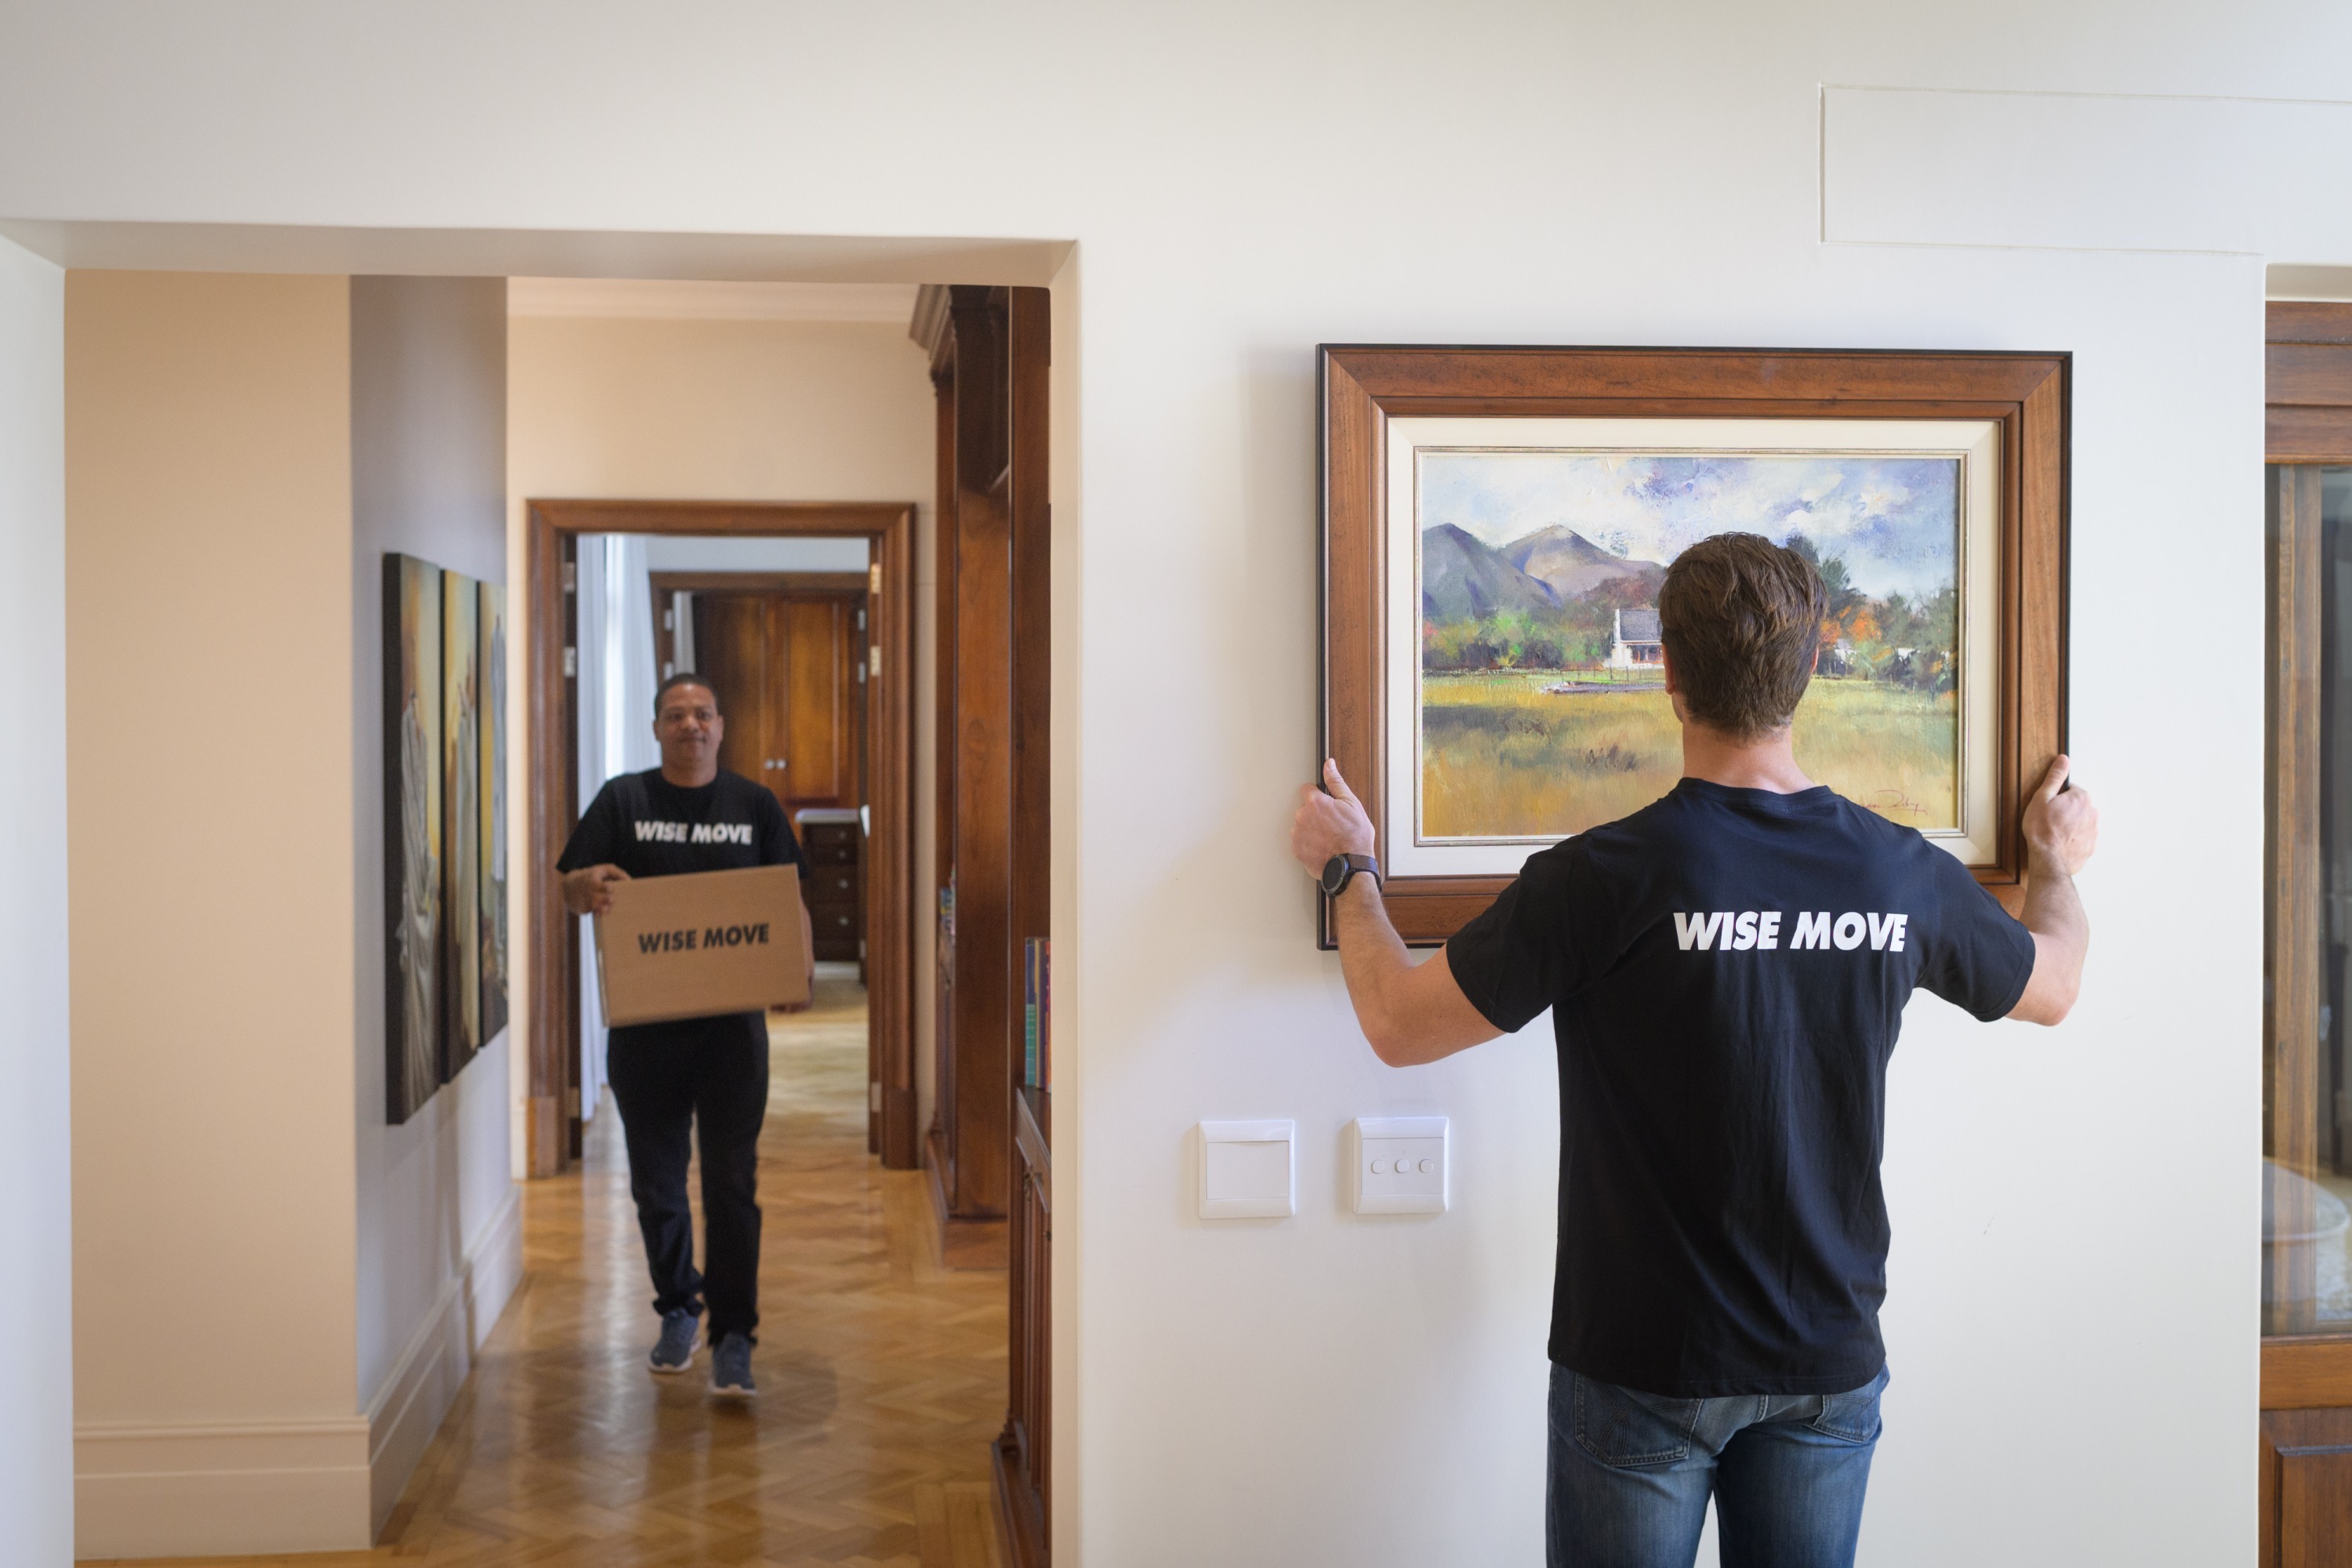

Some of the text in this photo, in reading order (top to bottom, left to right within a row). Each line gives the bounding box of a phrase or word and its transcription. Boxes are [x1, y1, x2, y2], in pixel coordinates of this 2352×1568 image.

[634, 821, 753, 845] WISE MOVE
[638, 924, 769, 954] WISE MOVE
[1673, 911, 1908, 952] WISE MOVE
